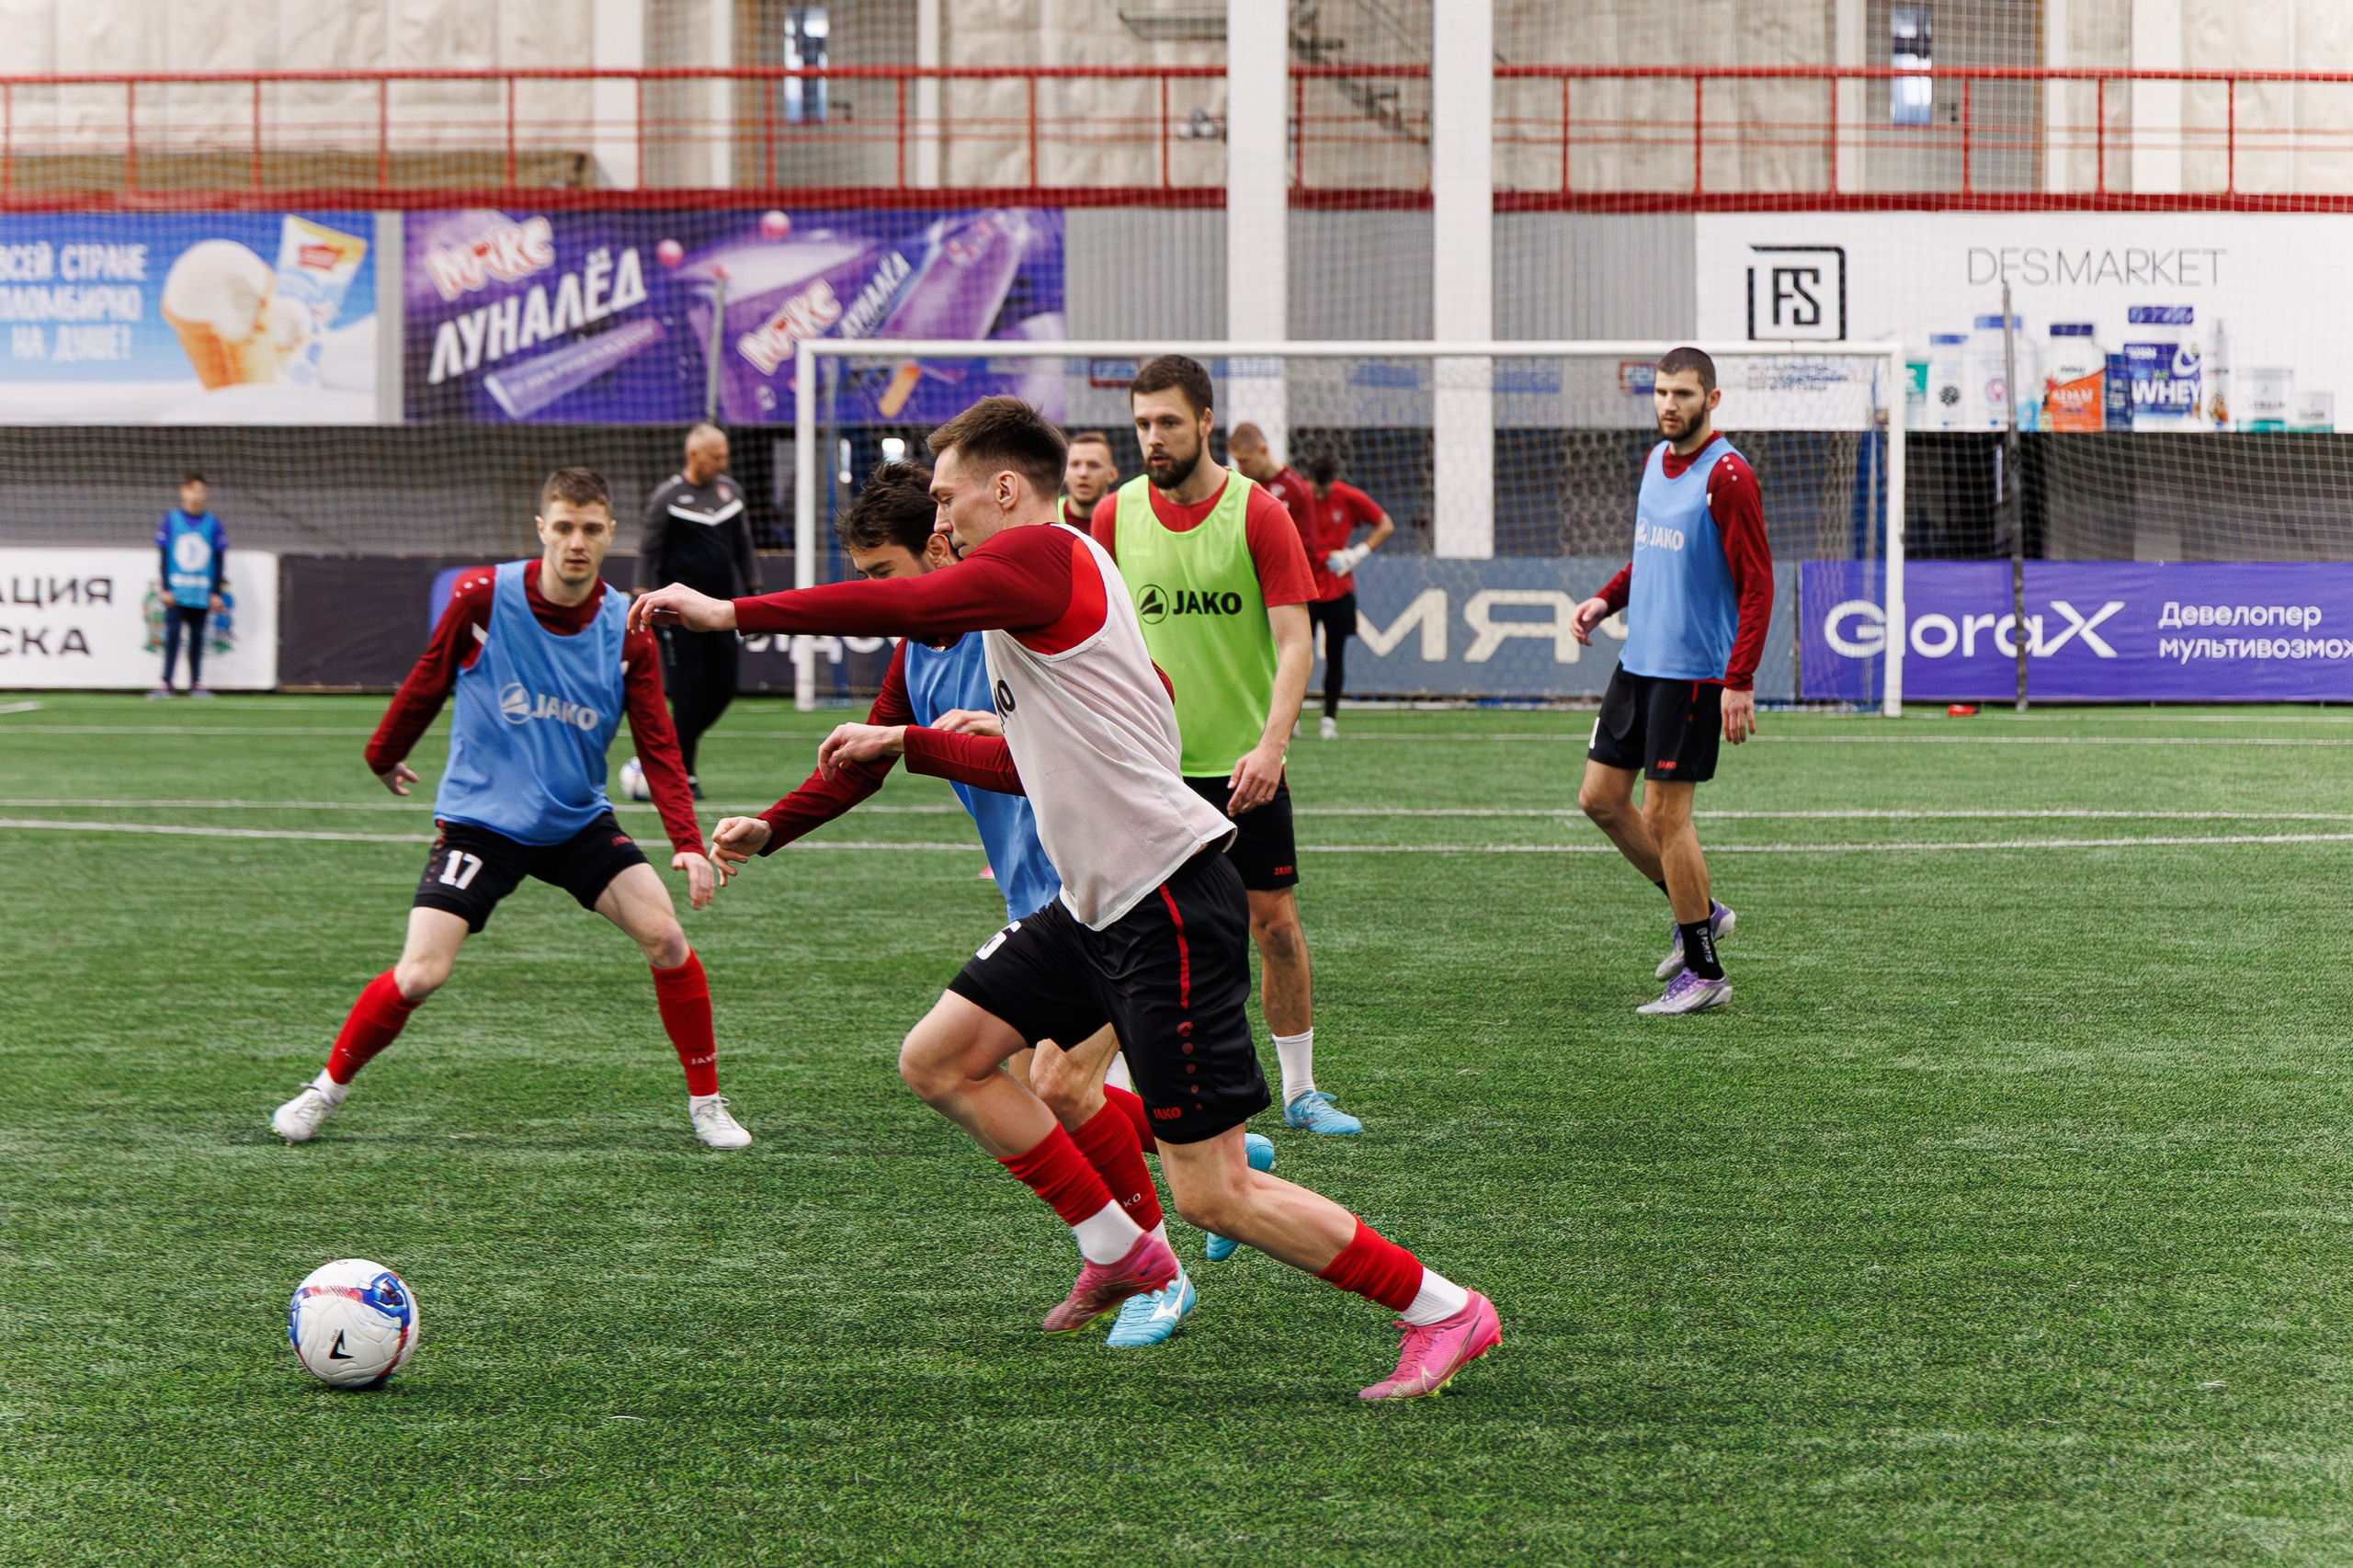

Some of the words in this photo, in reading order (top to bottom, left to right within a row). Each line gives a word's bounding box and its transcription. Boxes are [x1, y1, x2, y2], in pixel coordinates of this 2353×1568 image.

[428, 247, 647, 384] ЛУНАЛЁД
[2131, 379, 2202, 404] WHEY
[1649, 525, 1685, 552] JAKO
[0, 575, 111, 608] ЦИЯ
[1173, 590, 1242, 615] JAKO
[1317, 588, 1629, 663] МЯ
[1824, 599, 2125, 659] GoraX
[2158, 601, 2322, 632] Девелопер
[530, 692, 598, 732] JAKO
[438, 849, 483, 891] 17
[1123, 1192, 1142, 1208] KO
